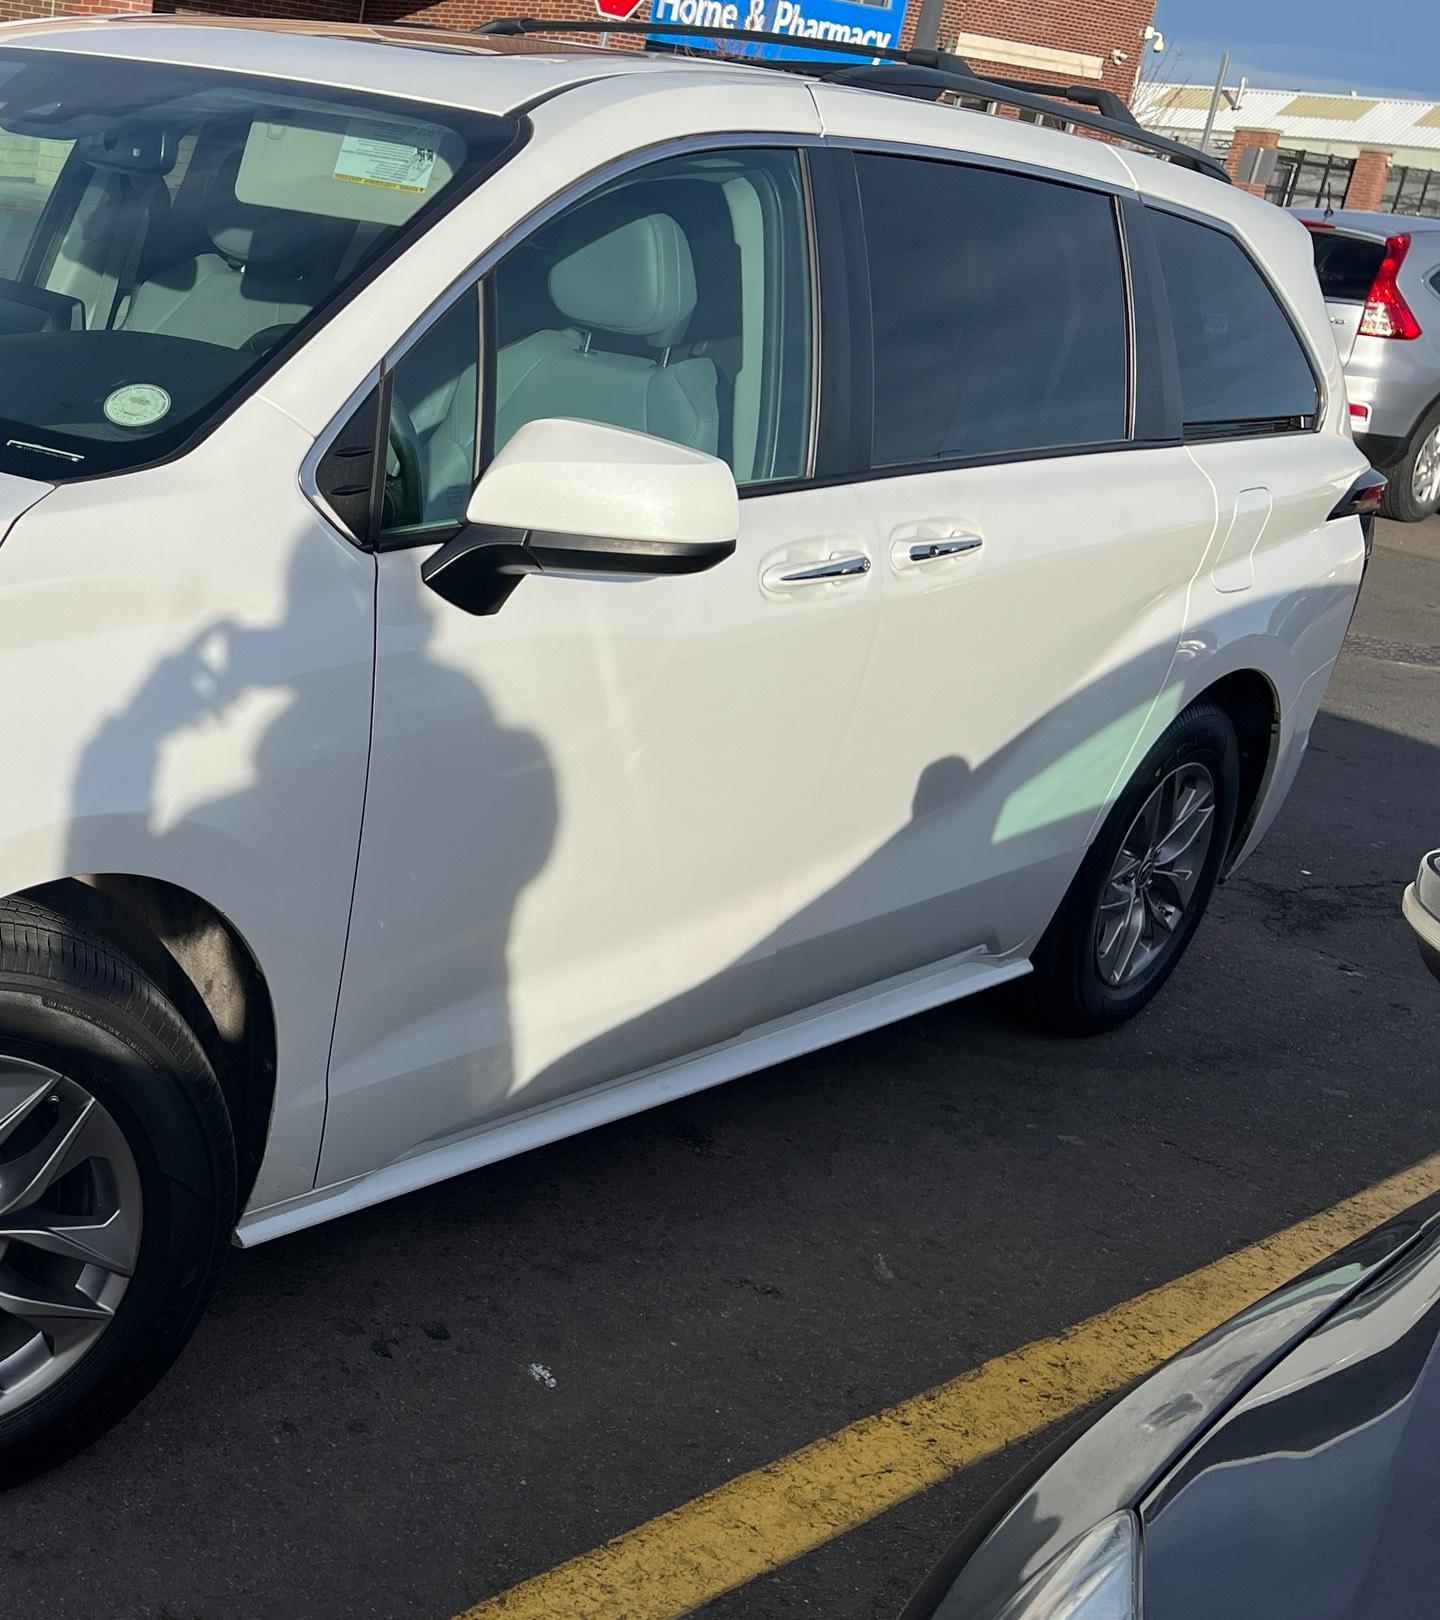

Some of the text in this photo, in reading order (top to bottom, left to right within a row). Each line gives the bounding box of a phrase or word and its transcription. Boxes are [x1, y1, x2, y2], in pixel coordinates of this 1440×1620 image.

[656, 0, 891, 65] Home & Pharmacy
